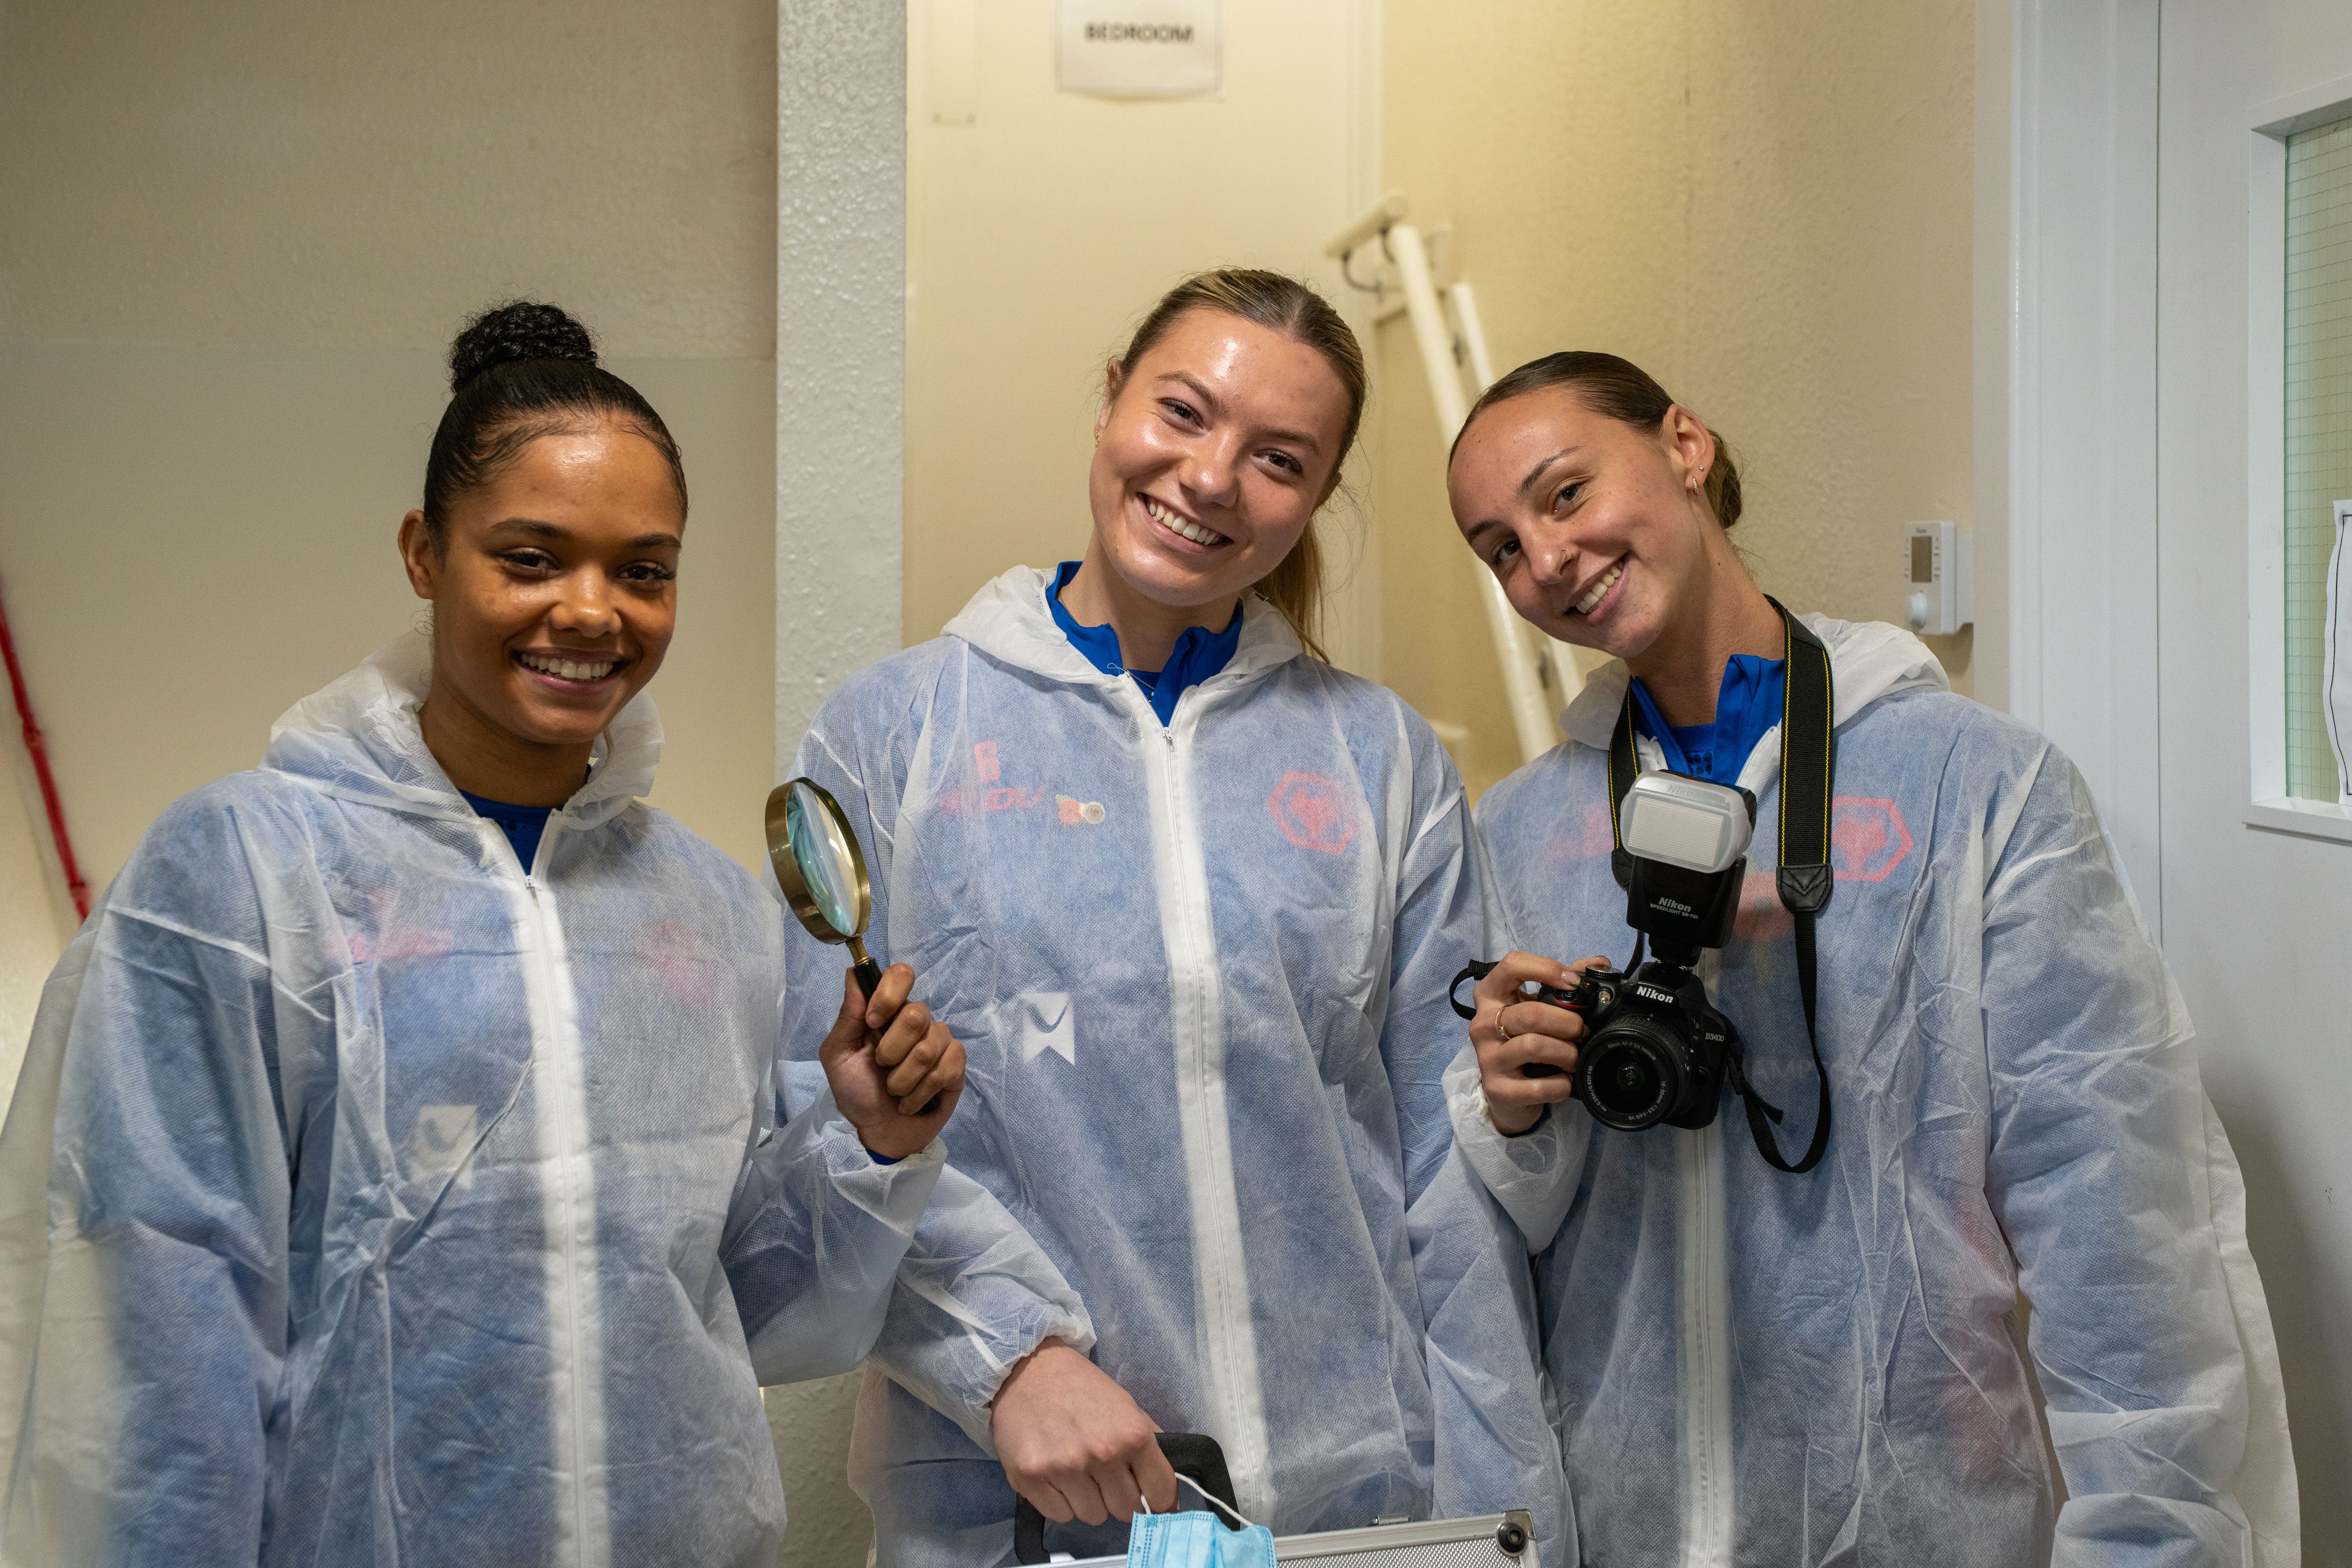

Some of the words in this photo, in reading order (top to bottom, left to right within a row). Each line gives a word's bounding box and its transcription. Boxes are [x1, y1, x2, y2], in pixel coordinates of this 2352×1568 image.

[1085, 22, 1194, 43] BEDROOM
[1650, 903, 1681, 915] SPEEDLIGHT
[1658, 897, 1692, 912] Nikon
[1636, 985, 1673, 1003] Nikon
[1705, 1032, 1724, 1042] D3400
